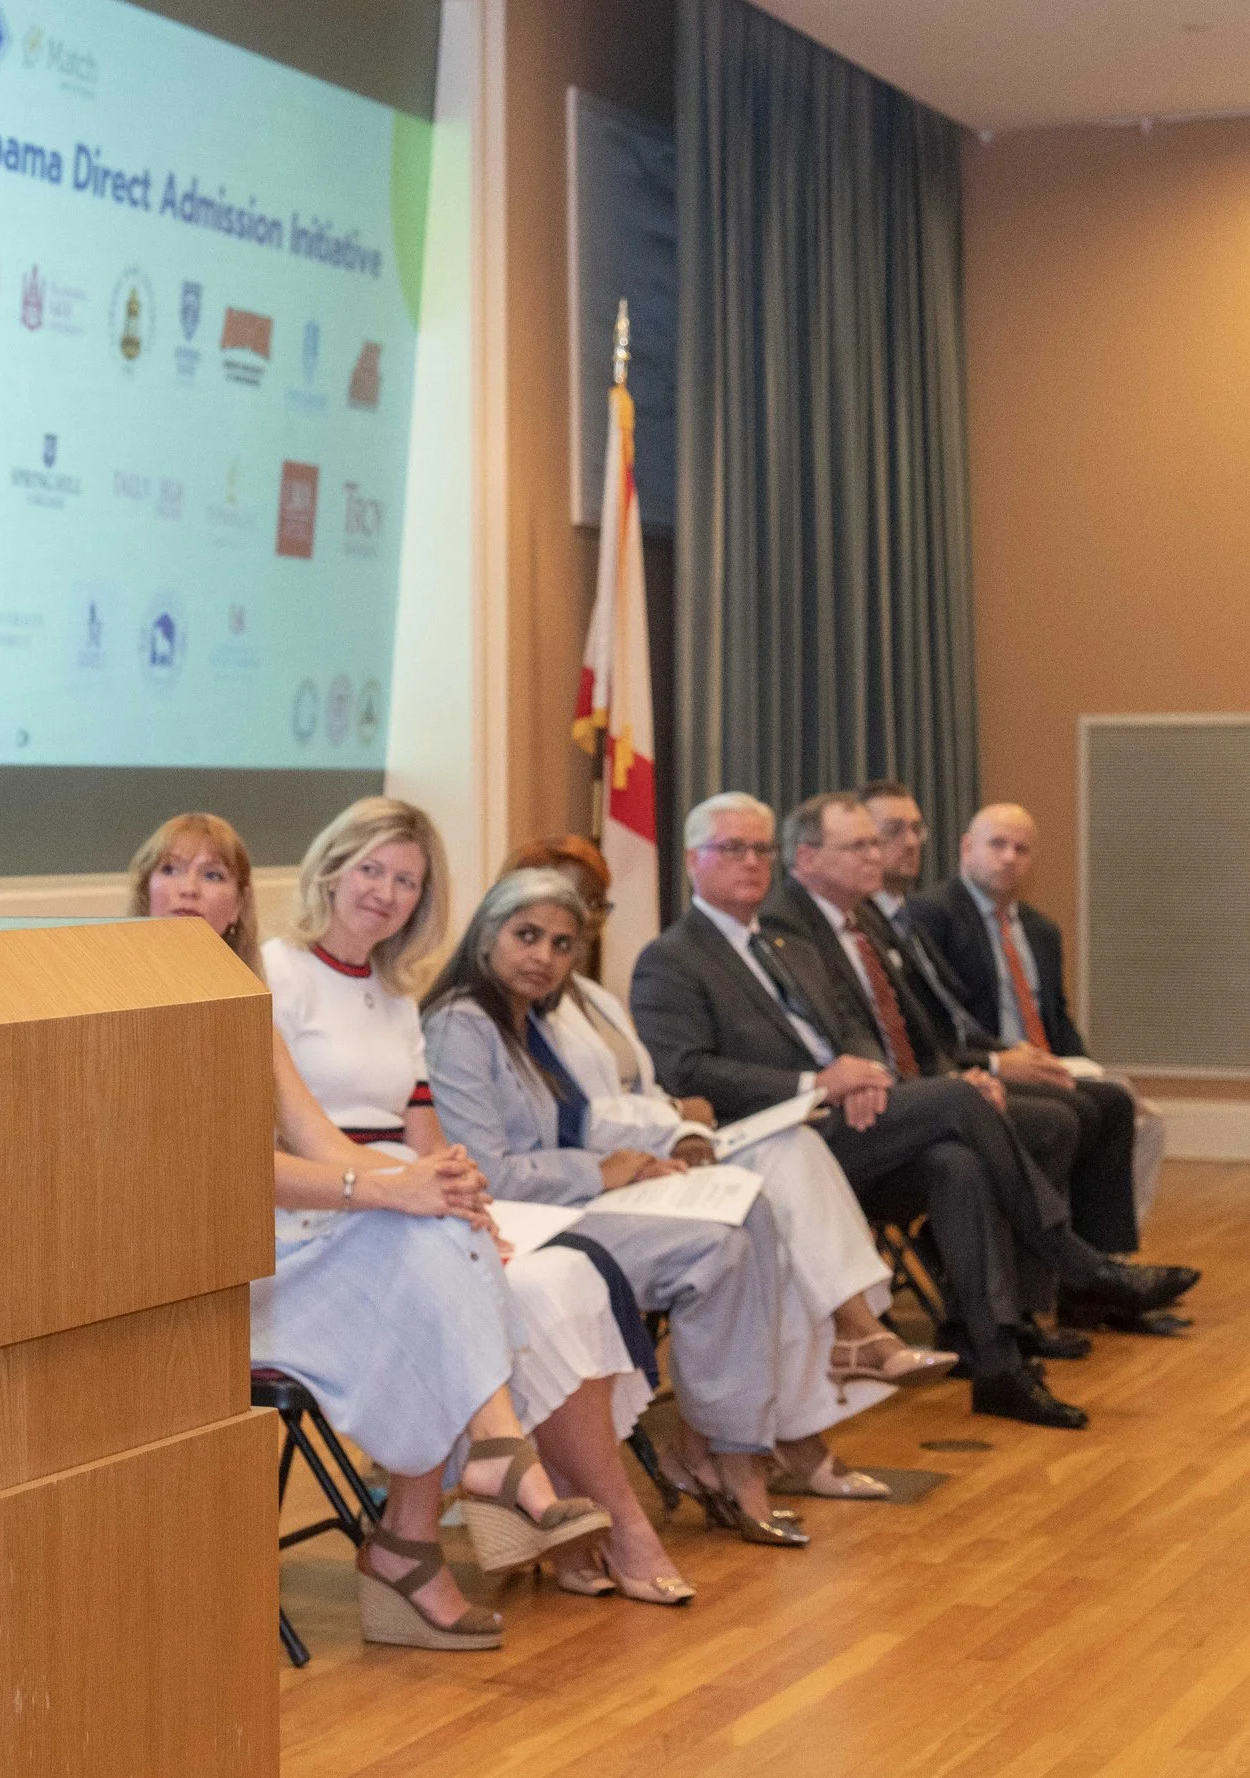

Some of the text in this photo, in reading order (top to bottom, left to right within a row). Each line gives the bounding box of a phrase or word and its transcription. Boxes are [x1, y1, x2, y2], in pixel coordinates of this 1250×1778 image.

[73, 142, 152, 212] Direct
[160, 171, 284, 251] Admission
[290, 210, 384, 280] Initiative
